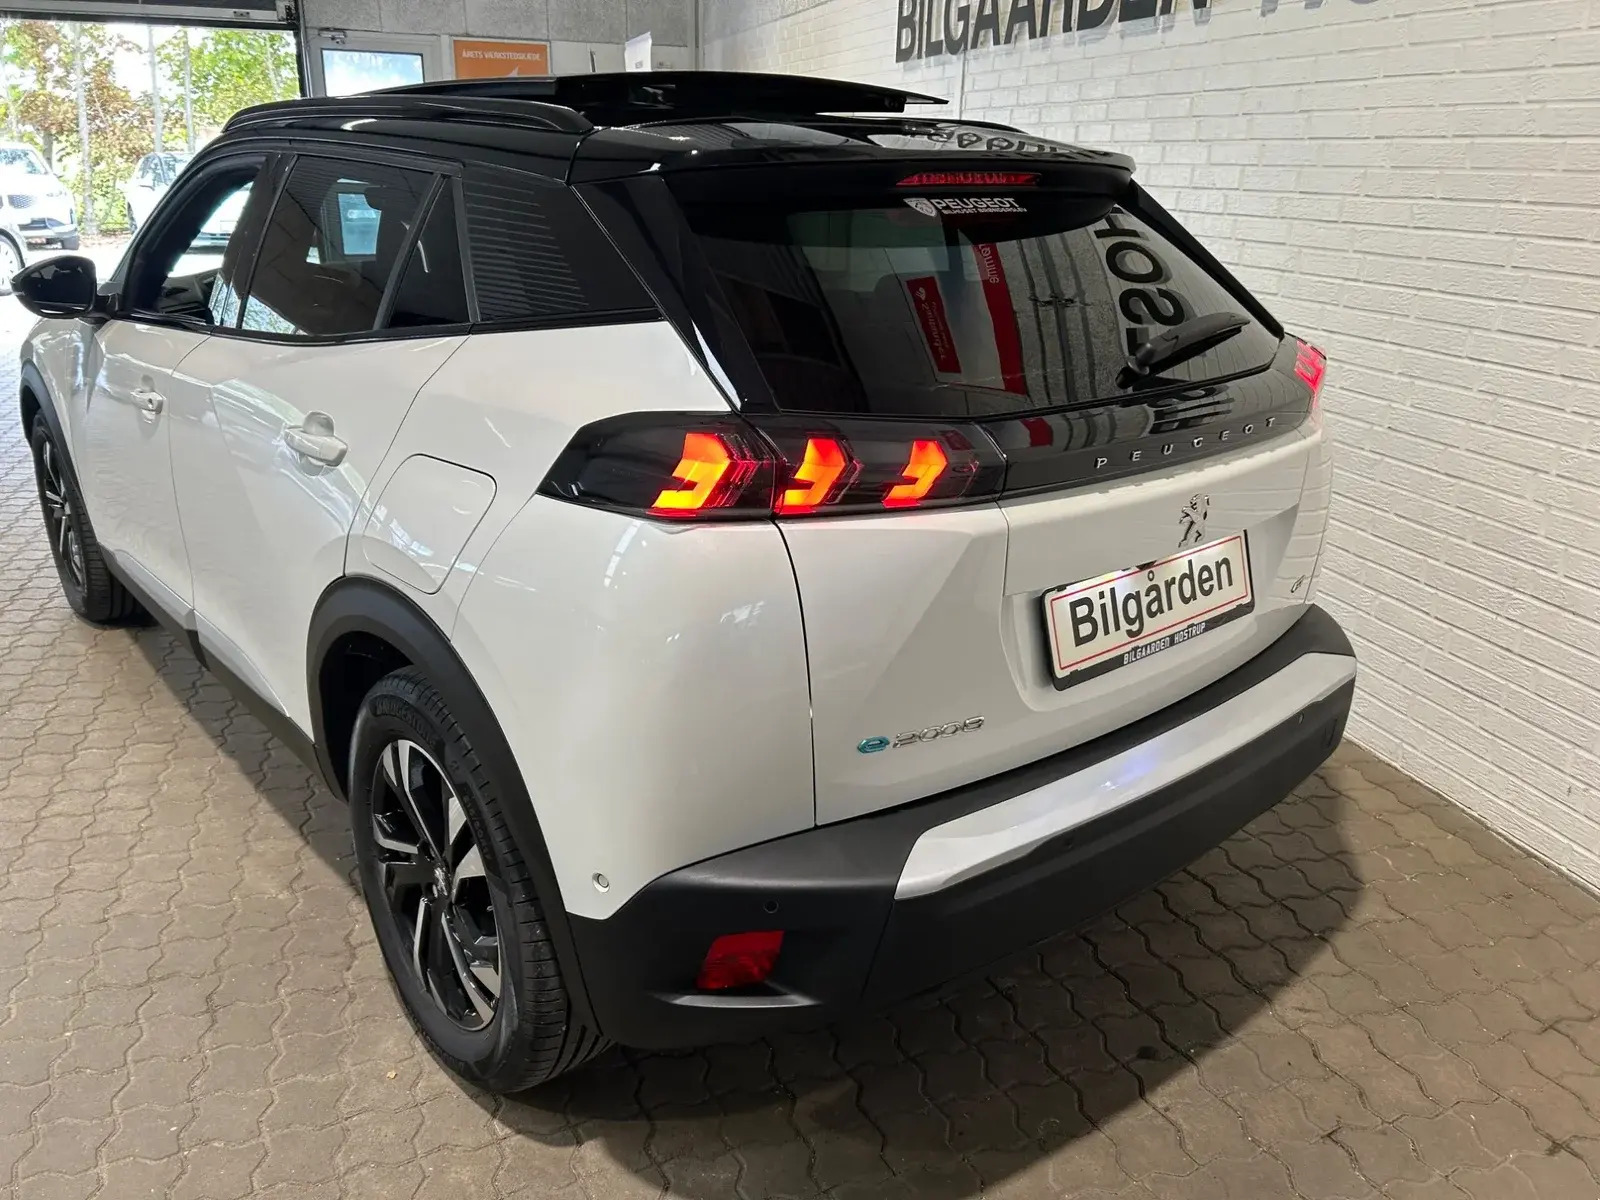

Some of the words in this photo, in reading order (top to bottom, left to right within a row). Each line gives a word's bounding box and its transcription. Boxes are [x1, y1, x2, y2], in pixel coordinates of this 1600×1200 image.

[929, 198, 1020, 210] PEUGEOT
[1094, 416, 1276, 470] PEUGEOT
[1068, 555, 1234, 648] Bilgården
[1123, 636, 1171, 666] BILGAARDEN
[1173, 622, 1207, 645] HOSTRUP
